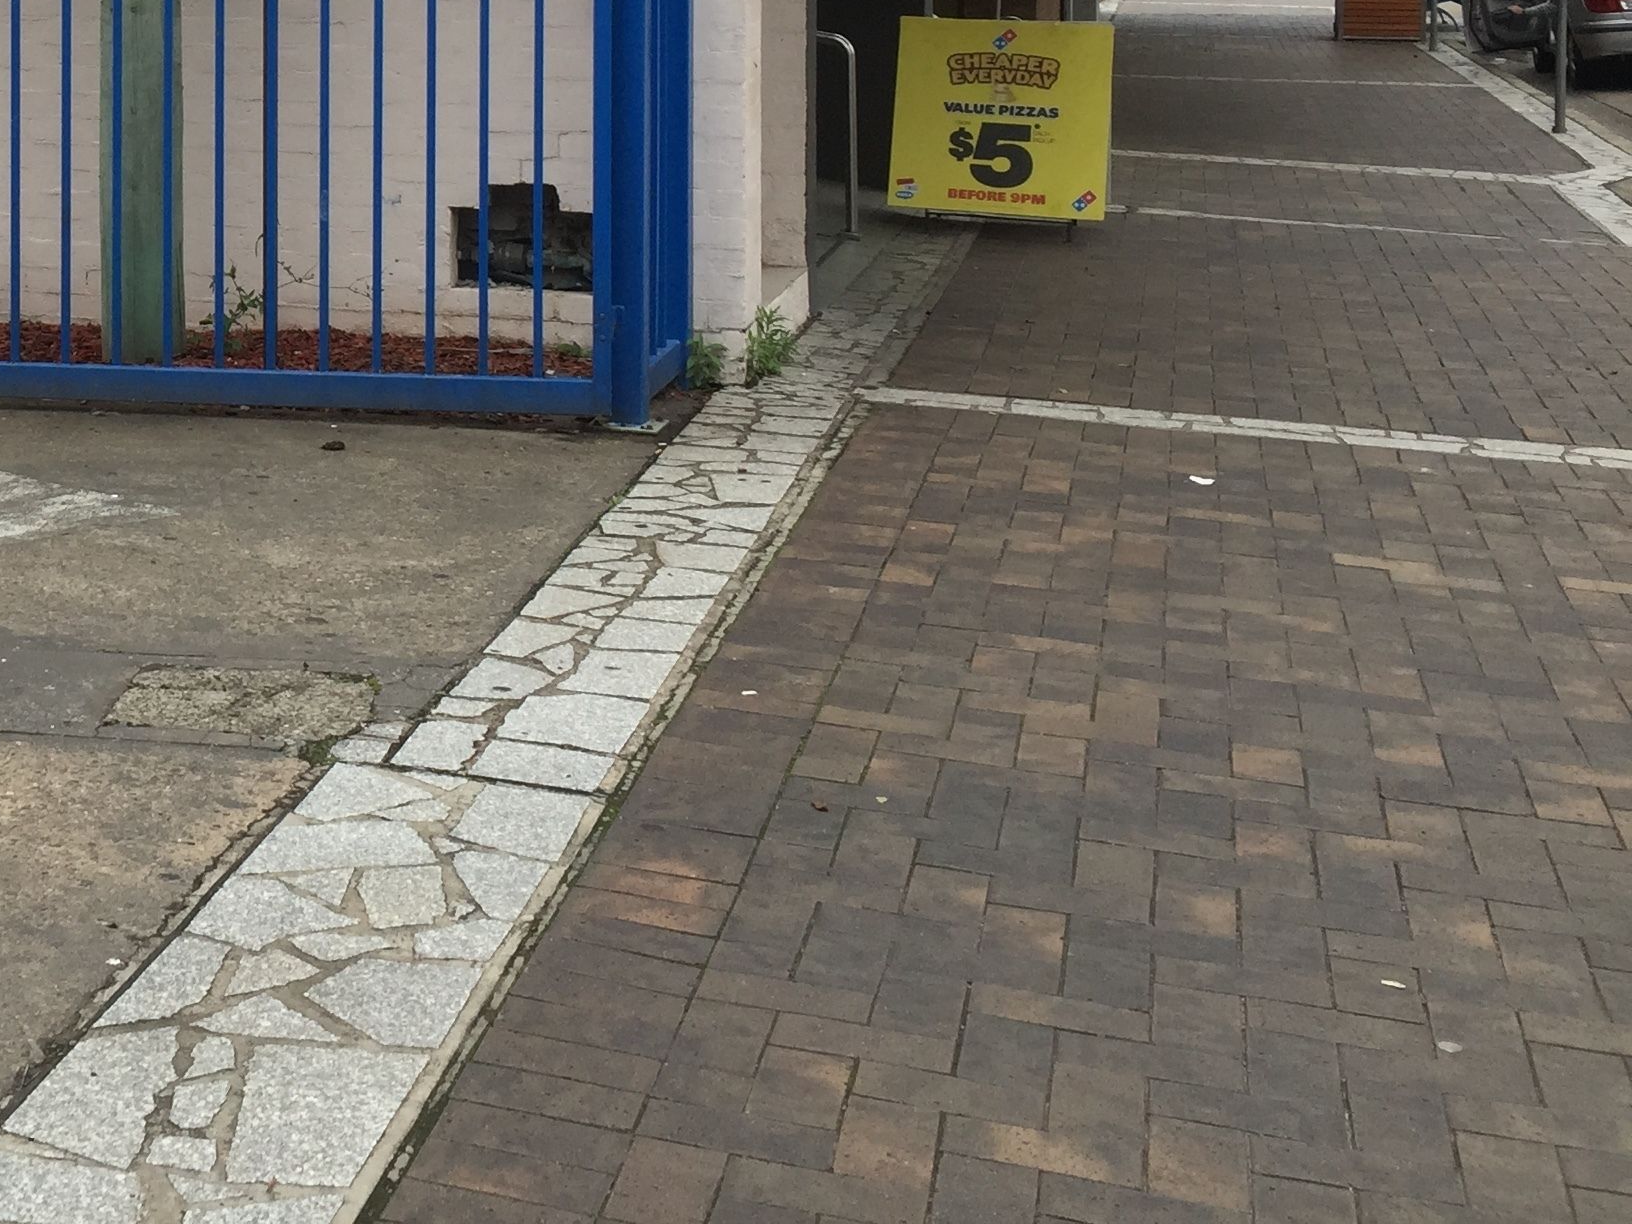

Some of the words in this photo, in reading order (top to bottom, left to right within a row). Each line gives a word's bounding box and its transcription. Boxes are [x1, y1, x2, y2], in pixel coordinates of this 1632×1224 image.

[947, 52, 1060, 75] CHEAPER
[949, 68, 1058, 89] EVERYDAY
[944, 101, 999, 115] VALUE
[998, 104, 1059, 119] PIZZAS
[947, 188, 1007, 203] BEFORE
[1010, 189, 1046, 205] 9PM
